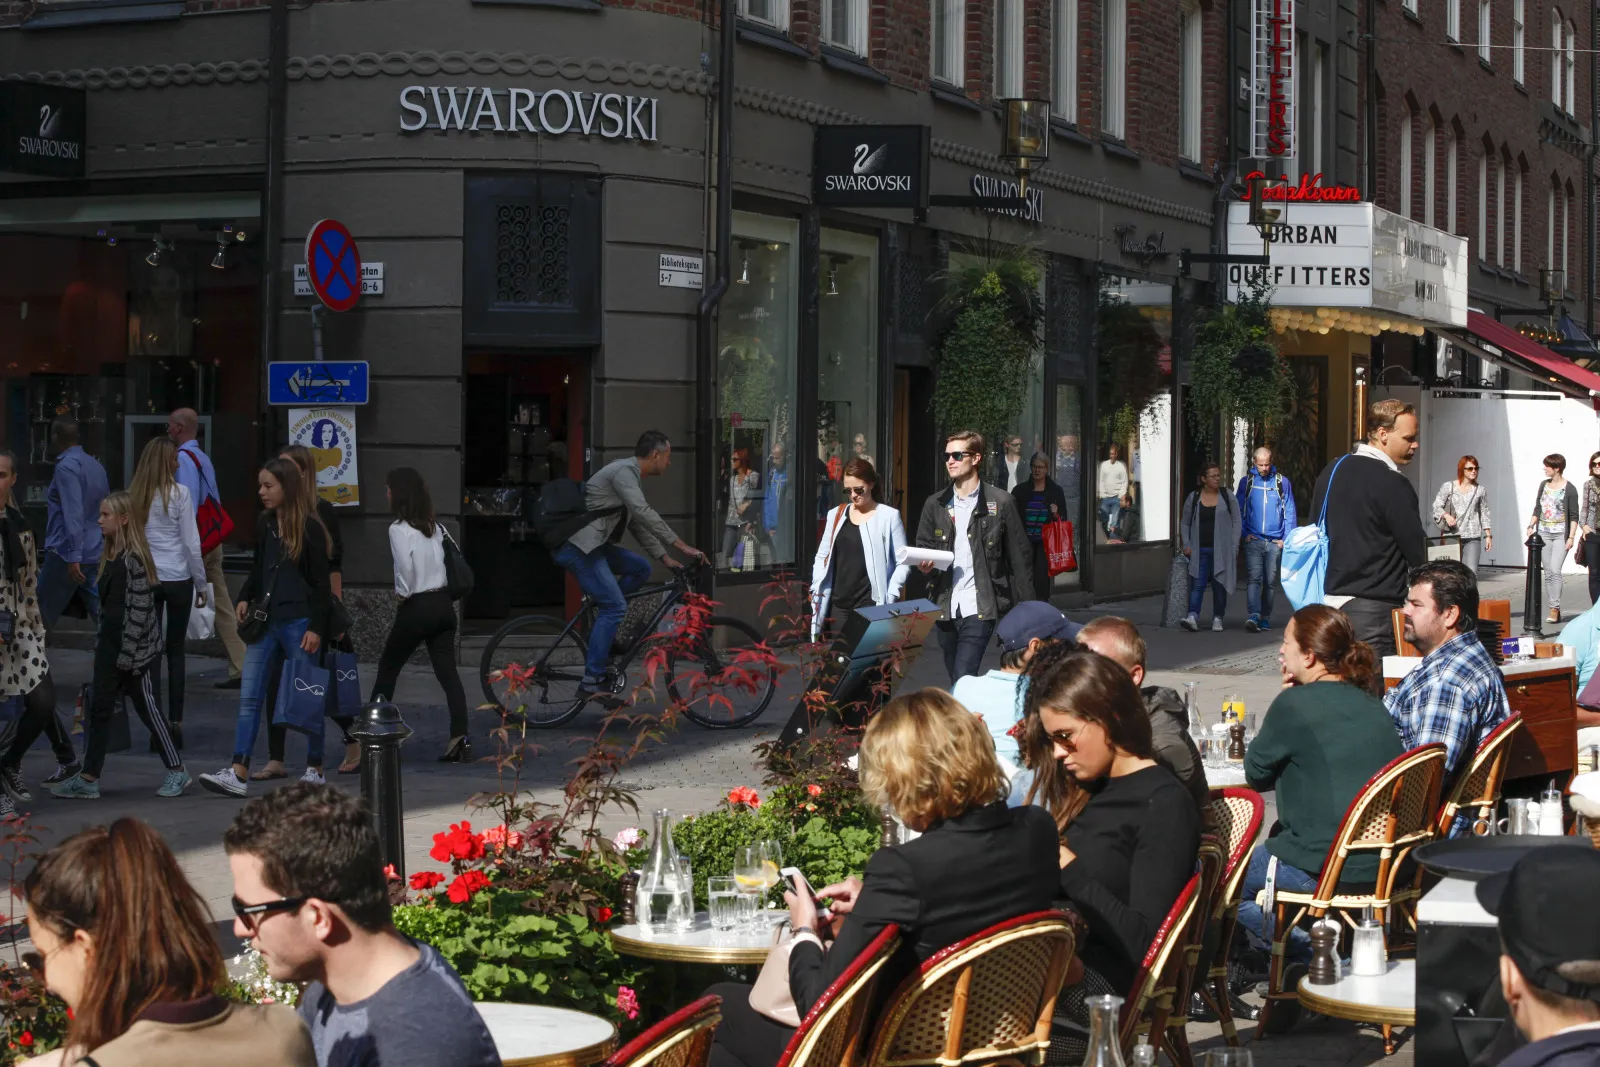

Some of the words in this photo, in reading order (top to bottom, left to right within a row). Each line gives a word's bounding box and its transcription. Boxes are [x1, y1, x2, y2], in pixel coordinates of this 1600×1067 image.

[399, 85, 658, 141] SWAROVSKI
[19, 136, 79, 160] SWAROVSKI
[825, 175, 912, 191] SWAROVSKI
[661, 257, 700, 272] Biblioteksgatan
[661, 273, 672, 284] 5-7
[1229, 265, 1371, 287] OUTFITTERS
